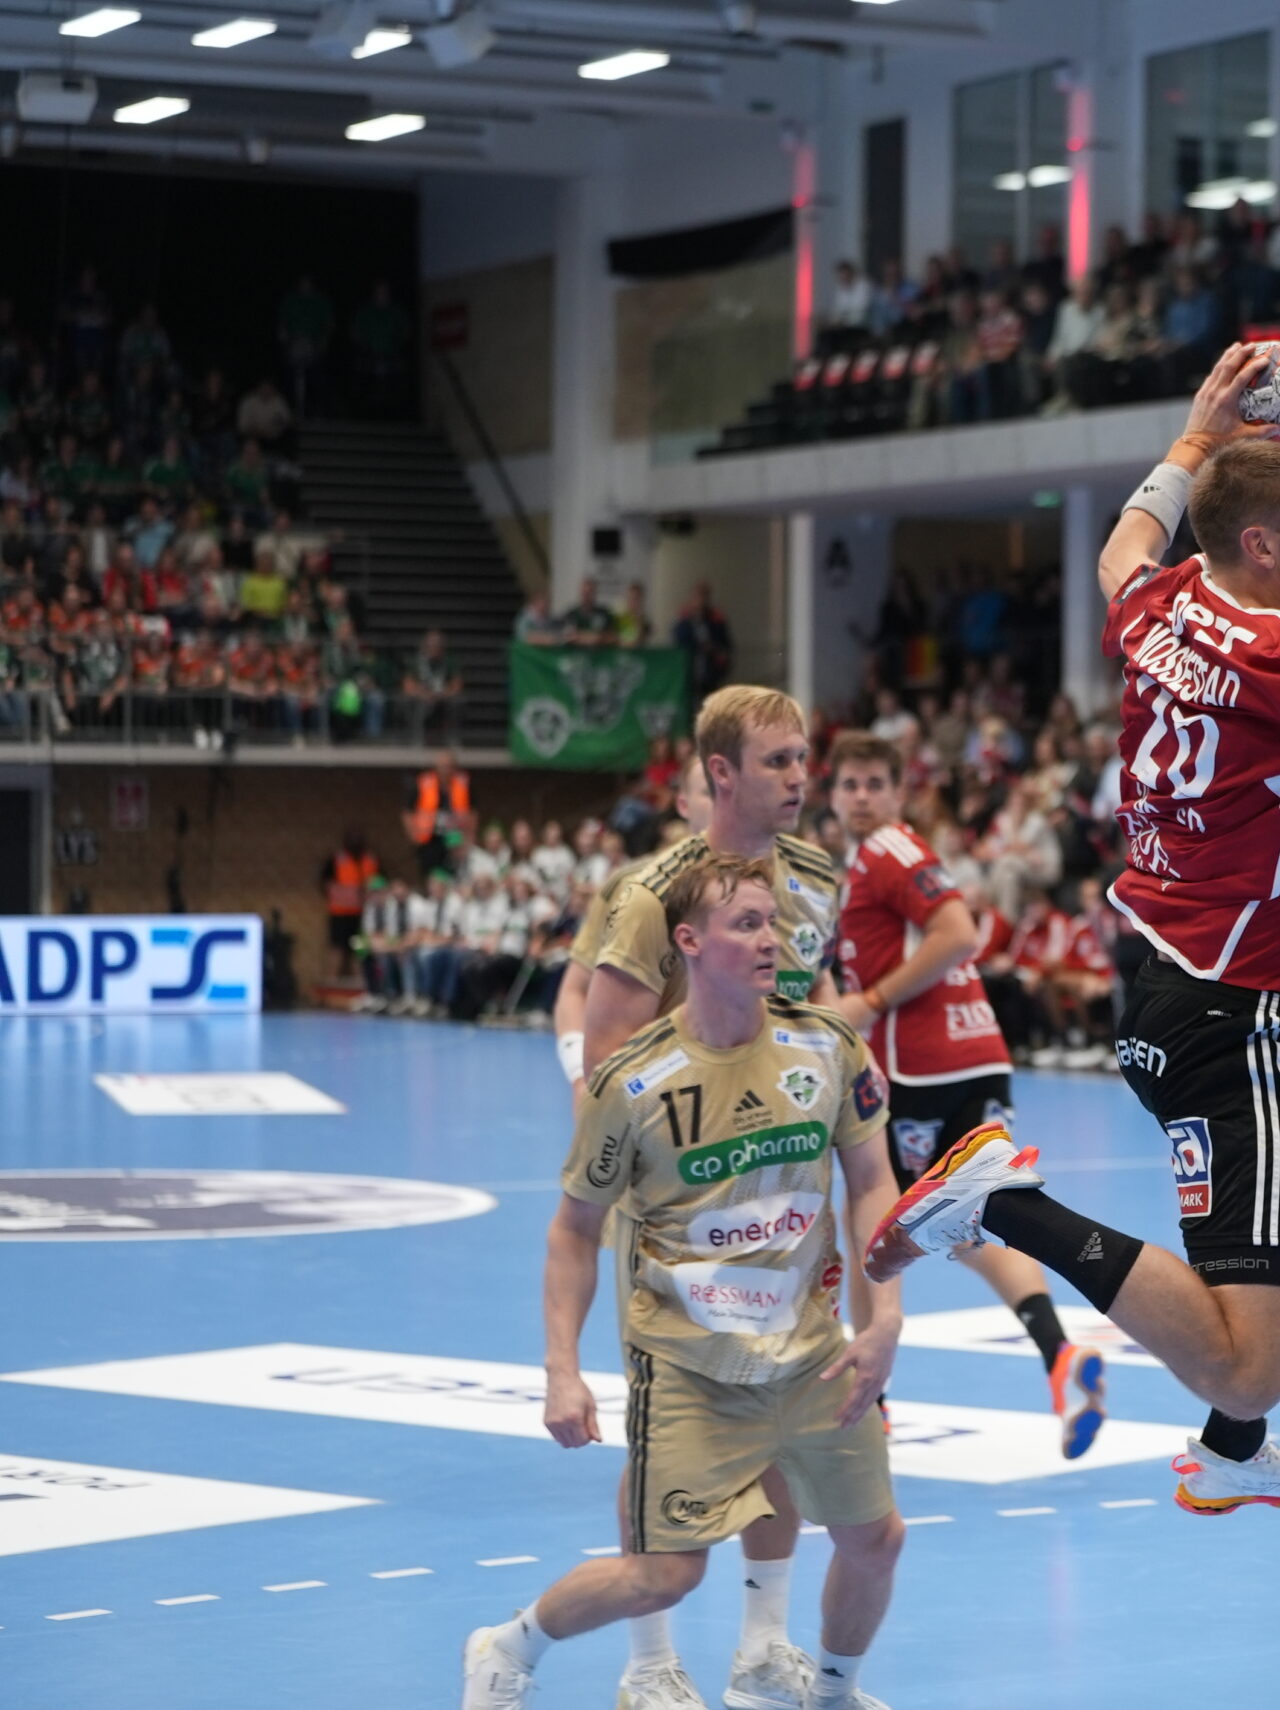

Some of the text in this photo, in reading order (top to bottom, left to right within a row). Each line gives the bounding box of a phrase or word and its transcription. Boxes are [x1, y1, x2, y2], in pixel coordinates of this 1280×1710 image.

[660, 1083, 702, 1148] 17
[598, 1135, 618, 1174] MTU
[690, 1131, 821, 1179] cp pharma
